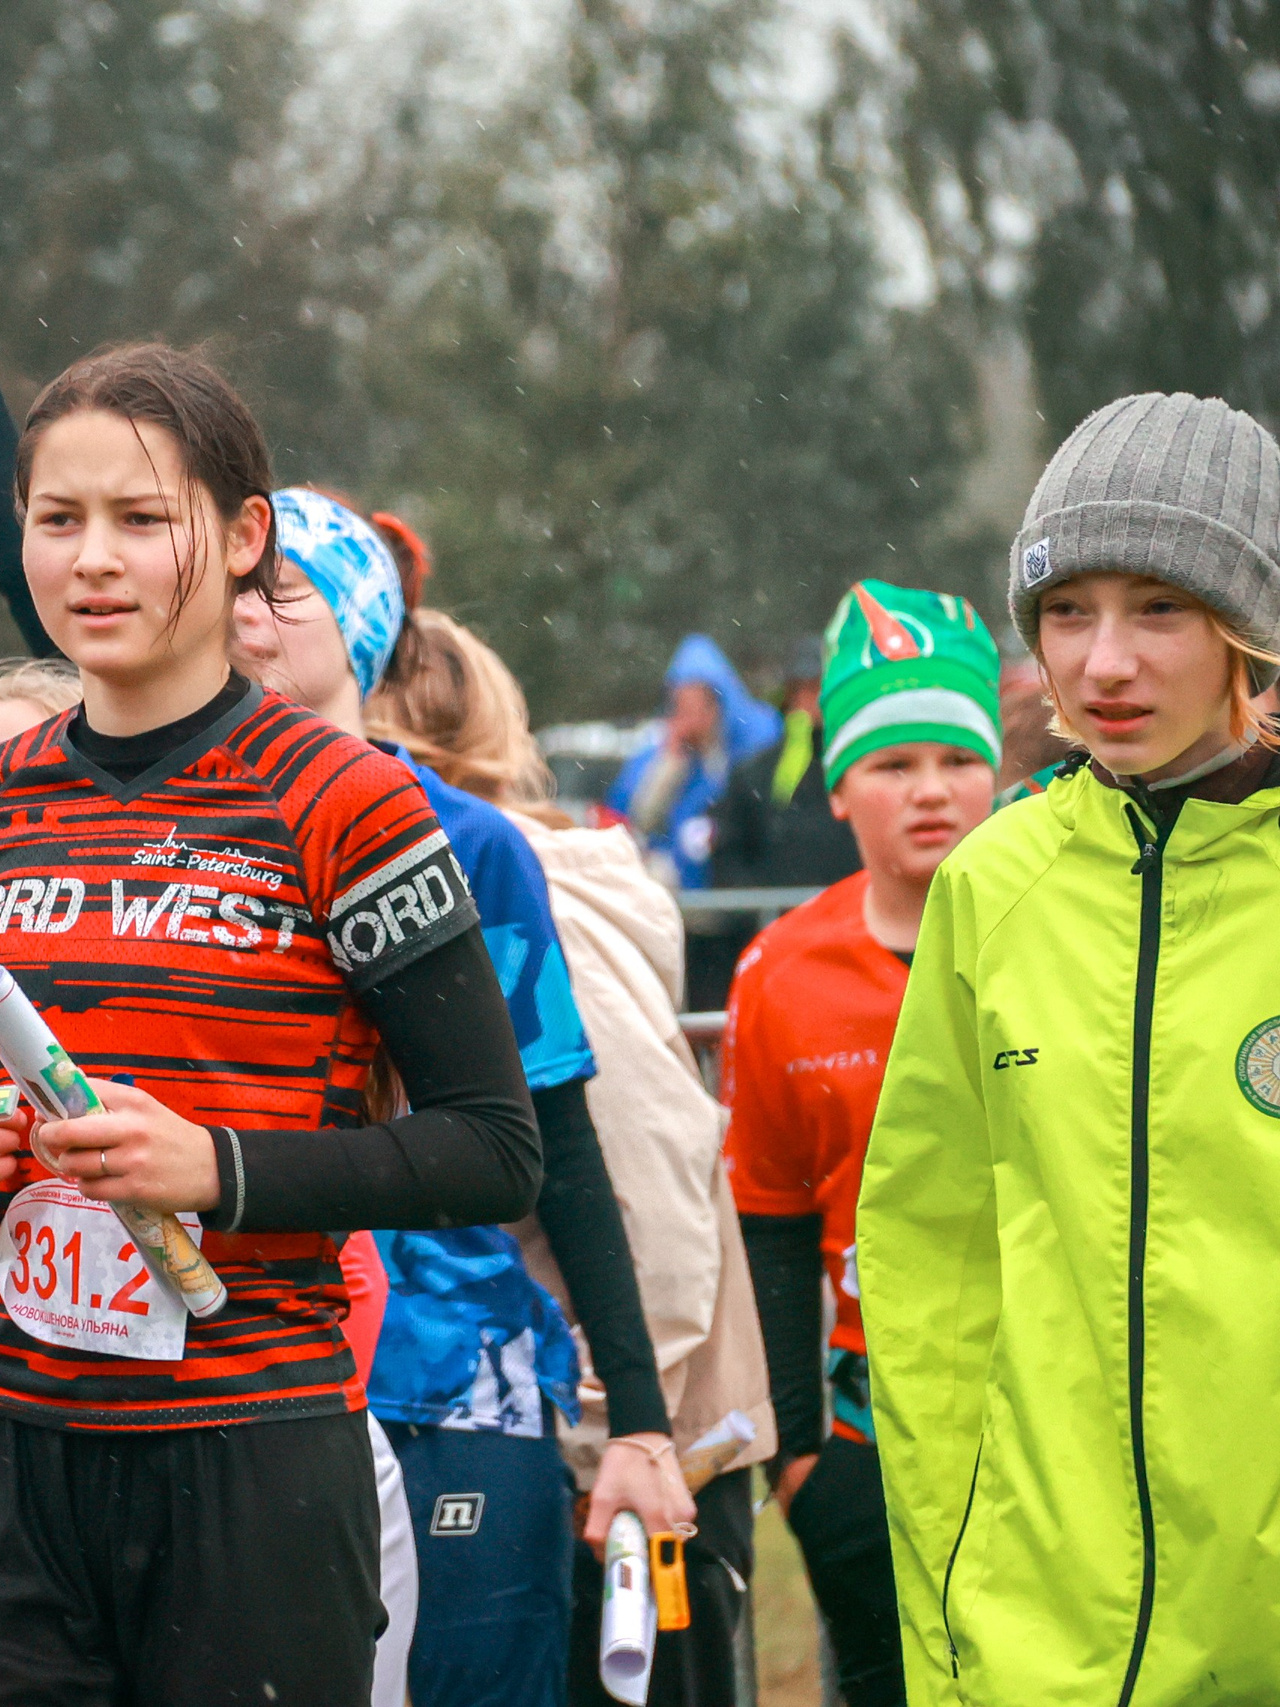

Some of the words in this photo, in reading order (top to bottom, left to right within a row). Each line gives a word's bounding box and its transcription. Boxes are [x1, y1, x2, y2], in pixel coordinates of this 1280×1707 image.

[131, 849, 283, 891] Saint-Petersburg
[112, 878, 313, 954] WEST
[10, 1220, 151, 1316] 331.2
[10, 1303, 79, 1330] НОВОКШЕНОВА
[80, 1318, 130, 1338] УЛЬЯНА
